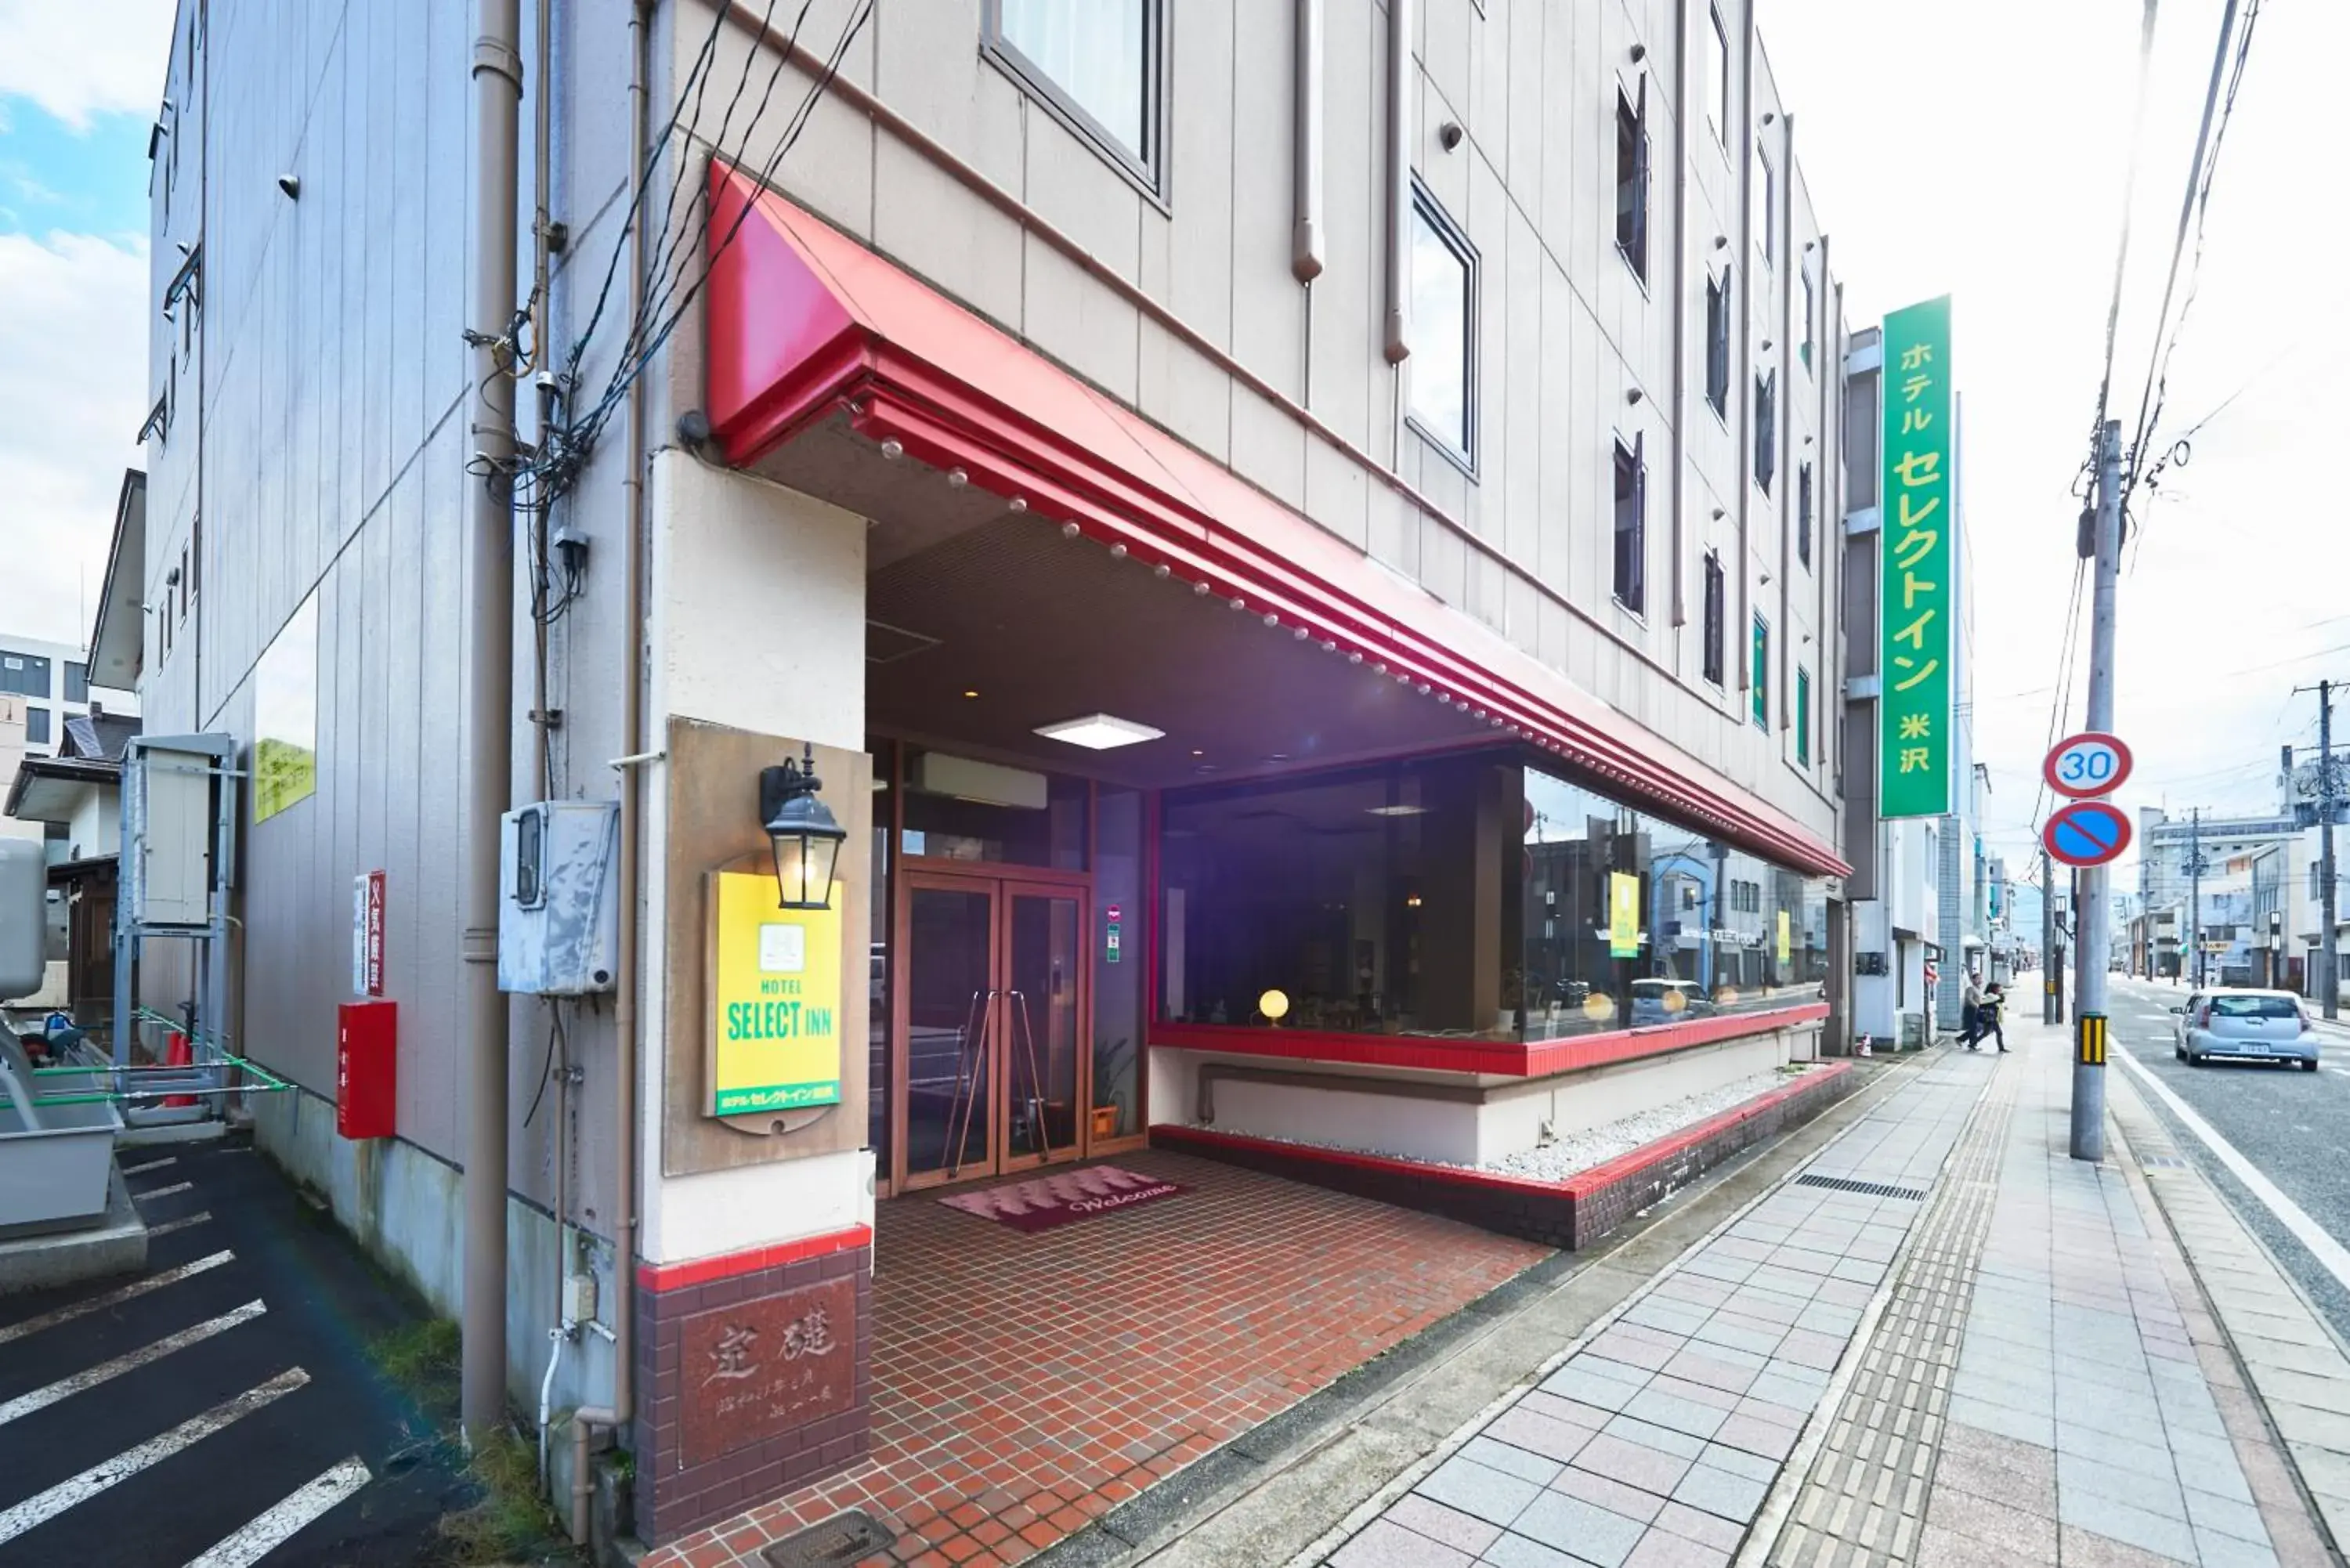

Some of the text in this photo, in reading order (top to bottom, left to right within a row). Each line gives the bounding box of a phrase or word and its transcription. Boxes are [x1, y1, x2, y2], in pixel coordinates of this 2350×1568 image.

[1893, 342, 1940, 773] ホテル セレクトイン 米沢
[2063, 751, 2111, 780] 30
[761, 979, 802, 994] HOTEL
[727, 1001, 832, 1041] SELECT INN
[1069, 1185, 1177, 1212] Welcome
